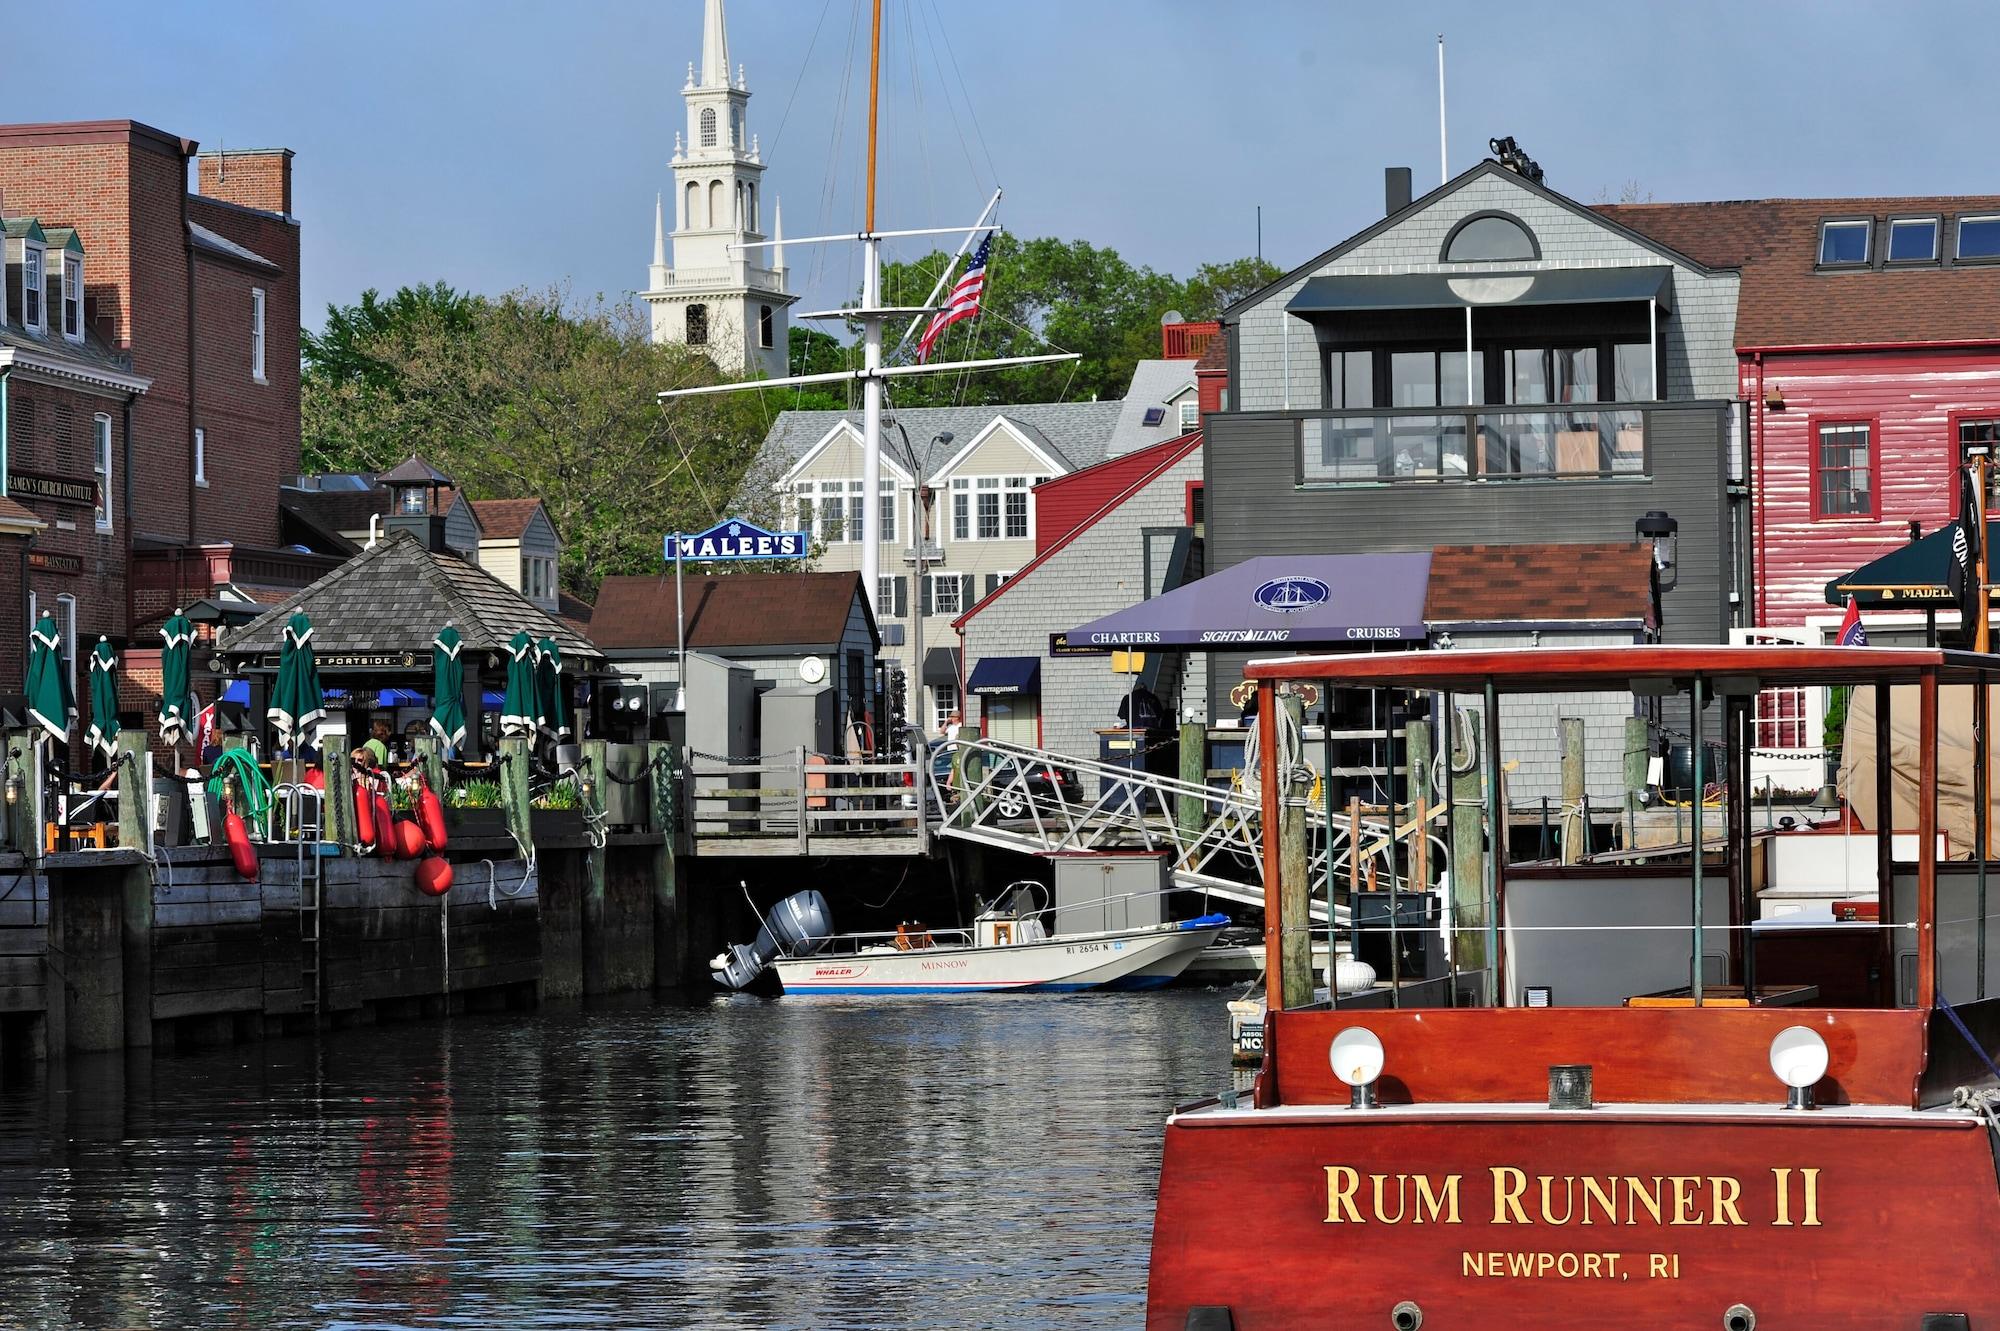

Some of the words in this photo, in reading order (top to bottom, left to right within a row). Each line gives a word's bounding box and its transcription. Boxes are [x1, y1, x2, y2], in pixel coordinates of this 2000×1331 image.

[37, 479, 61, 496] CHURCH
[62, 483, 92, 500] INSTITUTE
[674, 536, 796, 557] MALEE'S
[1091, 632, 1160, 643] CHARTERS
[1346, 627, 1401, 638] CRUISES
[328, 657, 390, 665] PORTSIDE
[1103, 943, 1109, 951] N
[815, 968, 852, 976] WHALER
[921, 959, 967, 970] MINNOW
[1770, 1167, 1823, 1226] II
[1462, 1251, 1629, 1281] NEWPORT,
[1649, 1252, 1680, 1279] RI
